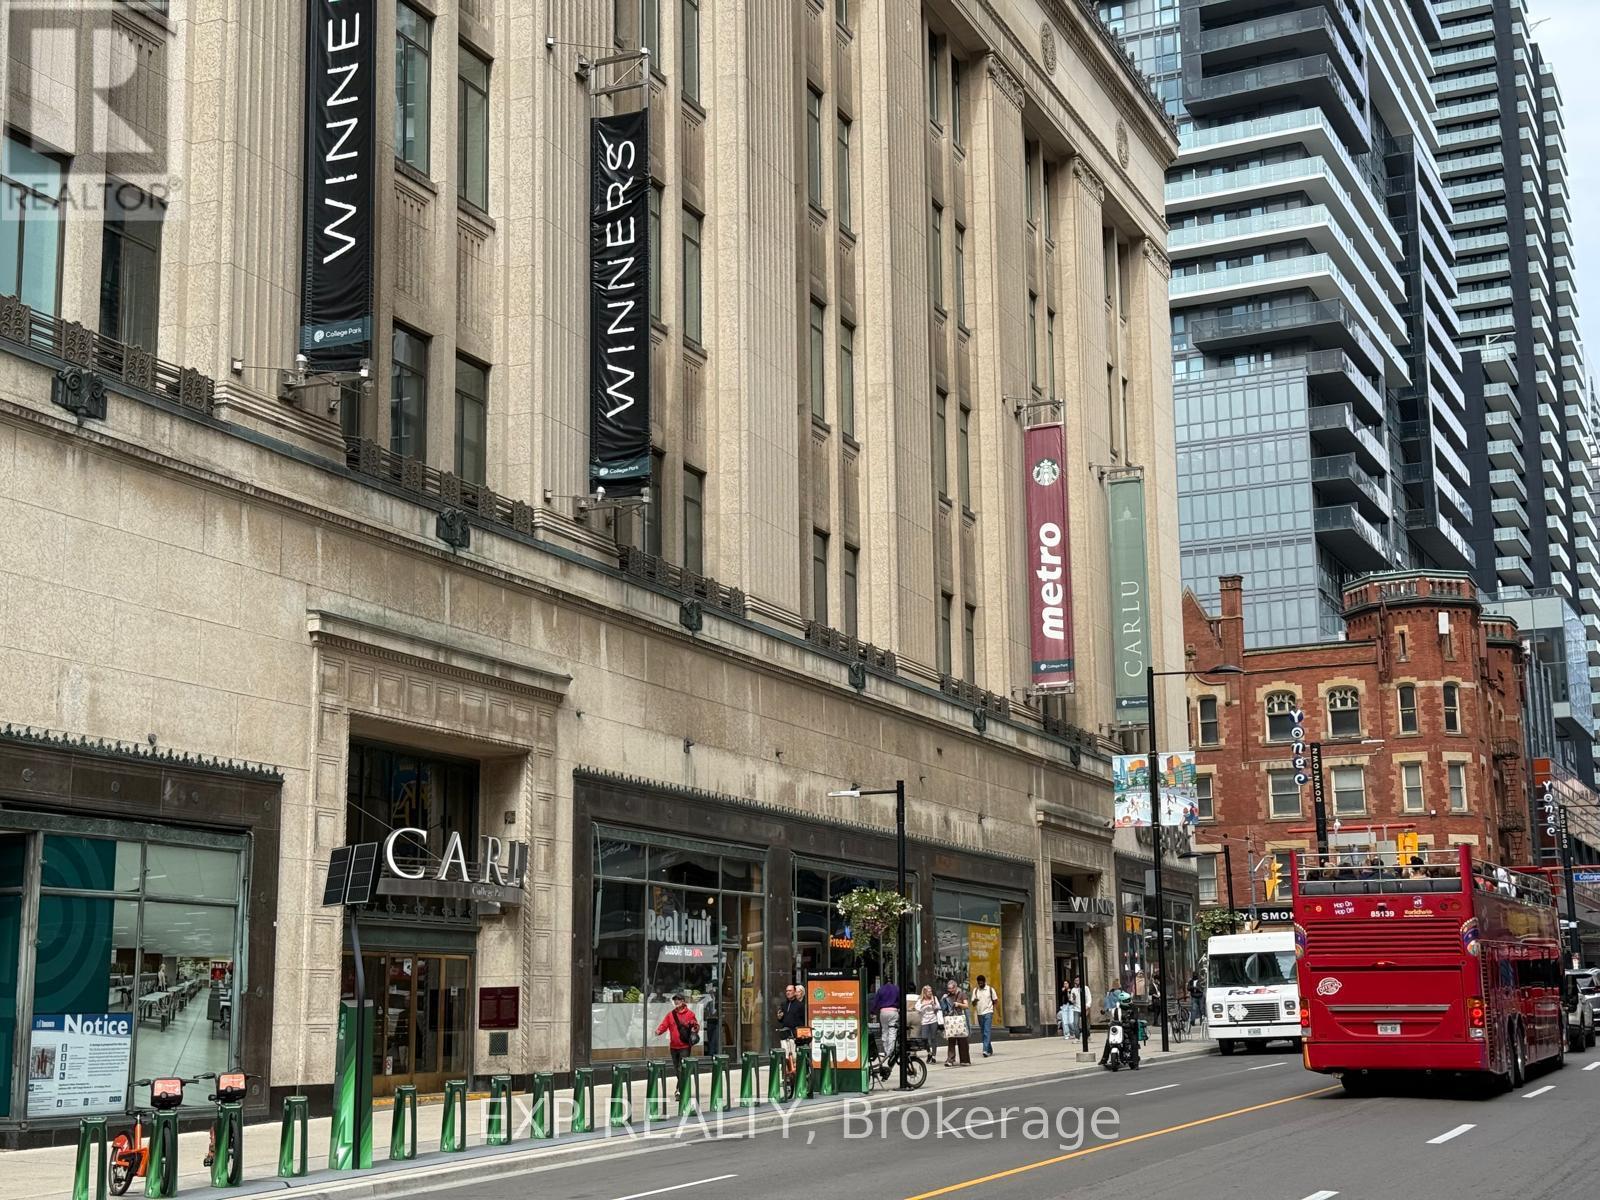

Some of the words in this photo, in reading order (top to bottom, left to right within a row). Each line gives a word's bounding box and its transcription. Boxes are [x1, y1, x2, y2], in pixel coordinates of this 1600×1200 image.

[322, 0, 361, 264] WINNE
[605, 140, 637, 418] WINNERS
[325, 328, 348, 339] College
[348, 326, 363, 336] Park
[609, 467, 628, 475] College
[1036, 522, 1065, 640] metro
[1120, 581, 1143, 678] CARLU
[1312, 747, 1322, 803] DOWNTOWN
[384, 827, 529, 888] CARL
[648, 909, 680, 944] Real
[681, 909, 712, 946] Fruit
[1261, 911, 1295, 920] SMOK
[1370, 910, 1395, 918] 85139
[1228, 988, 1278, 996] FedEx
[63, 1013, 129, 1036] Notice
